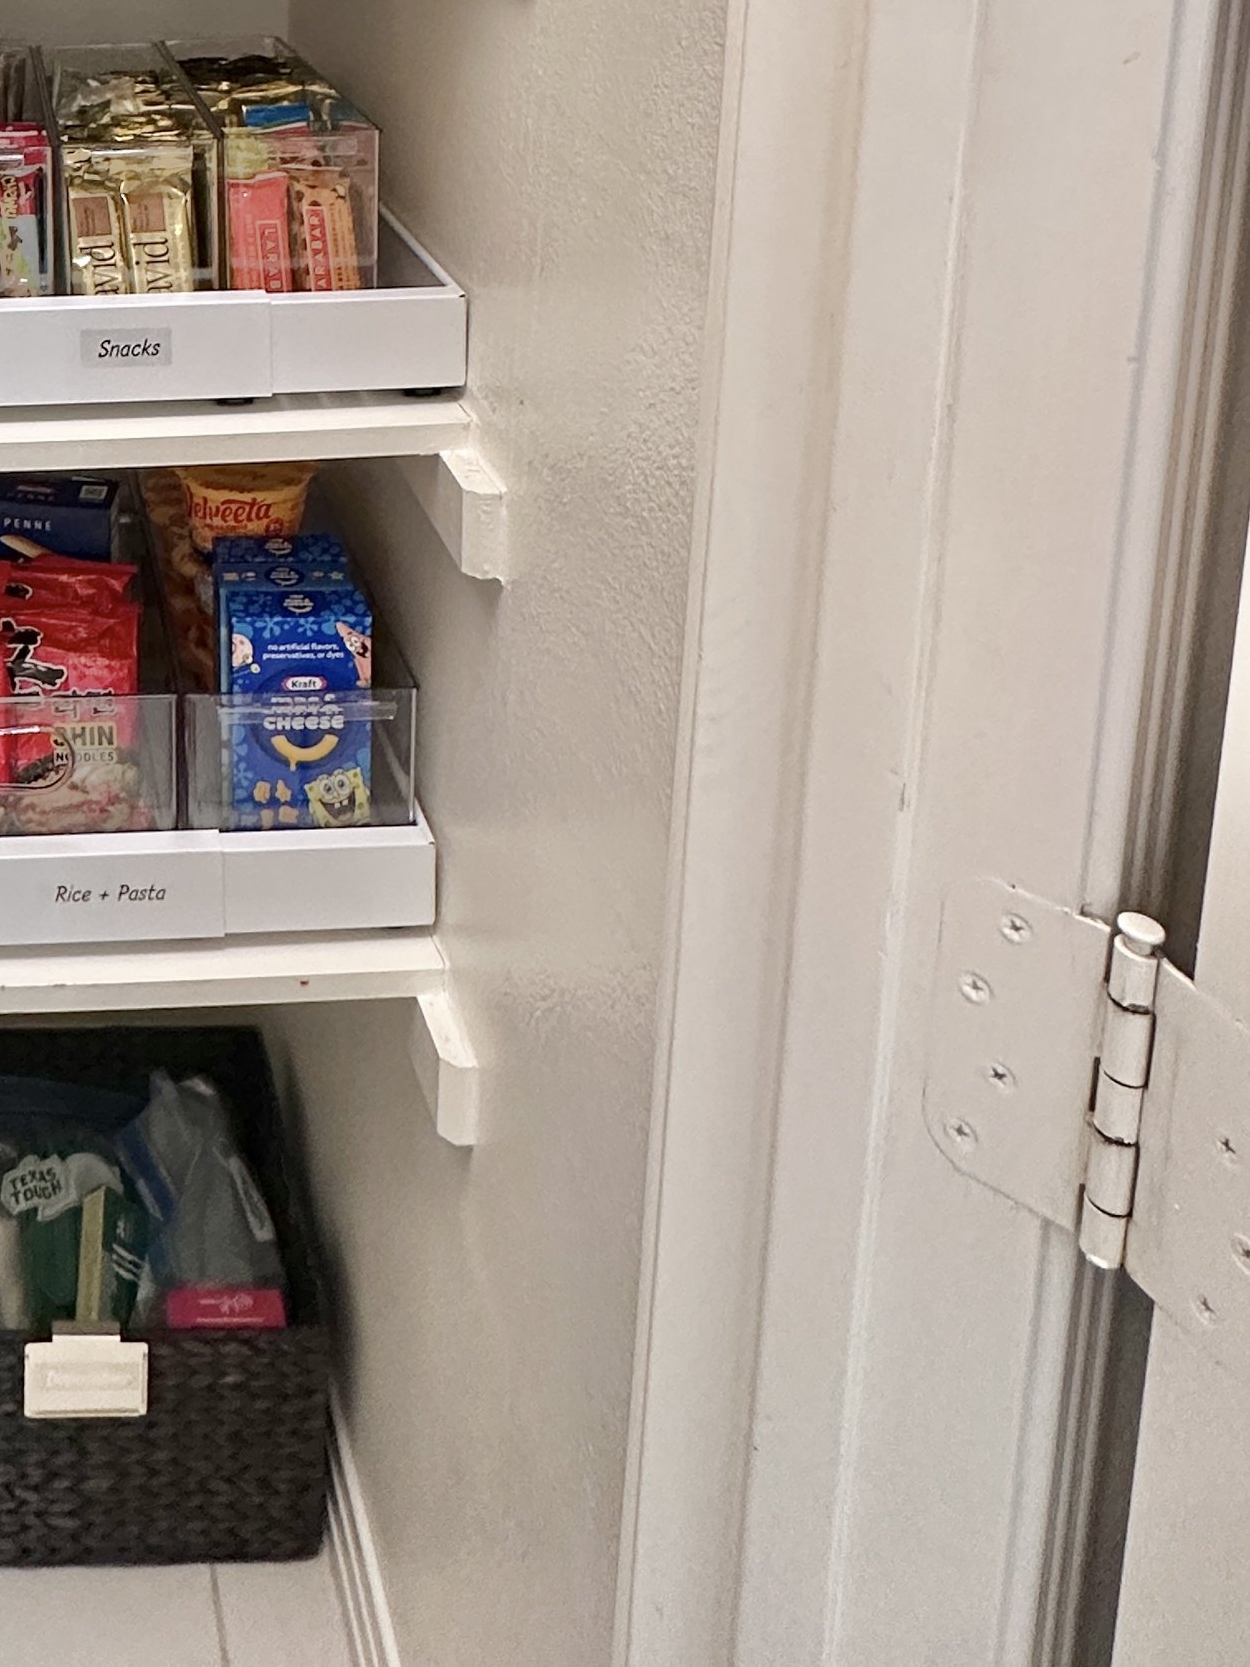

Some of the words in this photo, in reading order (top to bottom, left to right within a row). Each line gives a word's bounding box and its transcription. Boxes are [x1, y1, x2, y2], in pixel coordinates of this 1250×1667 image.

[0, 174, 19, 220] CHEWY
[261, 224, 282, 291] LARAB
[307, 210, 333, 291] ARABAR
[92, 233, 117, 295] avid
[135, 236, 169, 294] avid
[98, 337, 161, 360] Snacks
[3, 517, 52, 532] PENNE
[262, 652, 316, 660] preservatives,
[326, 651, 344, 660] dyes
[279, 643, 310, 651] artificial
[311, 642, 339, 651] flavors,
[291, 679, 317, 688] Kraft
[262, 715, 345, 731] CHEESE
[53, 726, 115, 748] SHIN
[55, 751, 114, 764] NOODLES
[55, 884, 93, 905] Rice
[100, 889, 111, 901] +
[117, 882, 168, 904] Pasta
[9, 1167, 57, 1191] TEXAS
[10, 1180, 63, 1205] TOUGH
